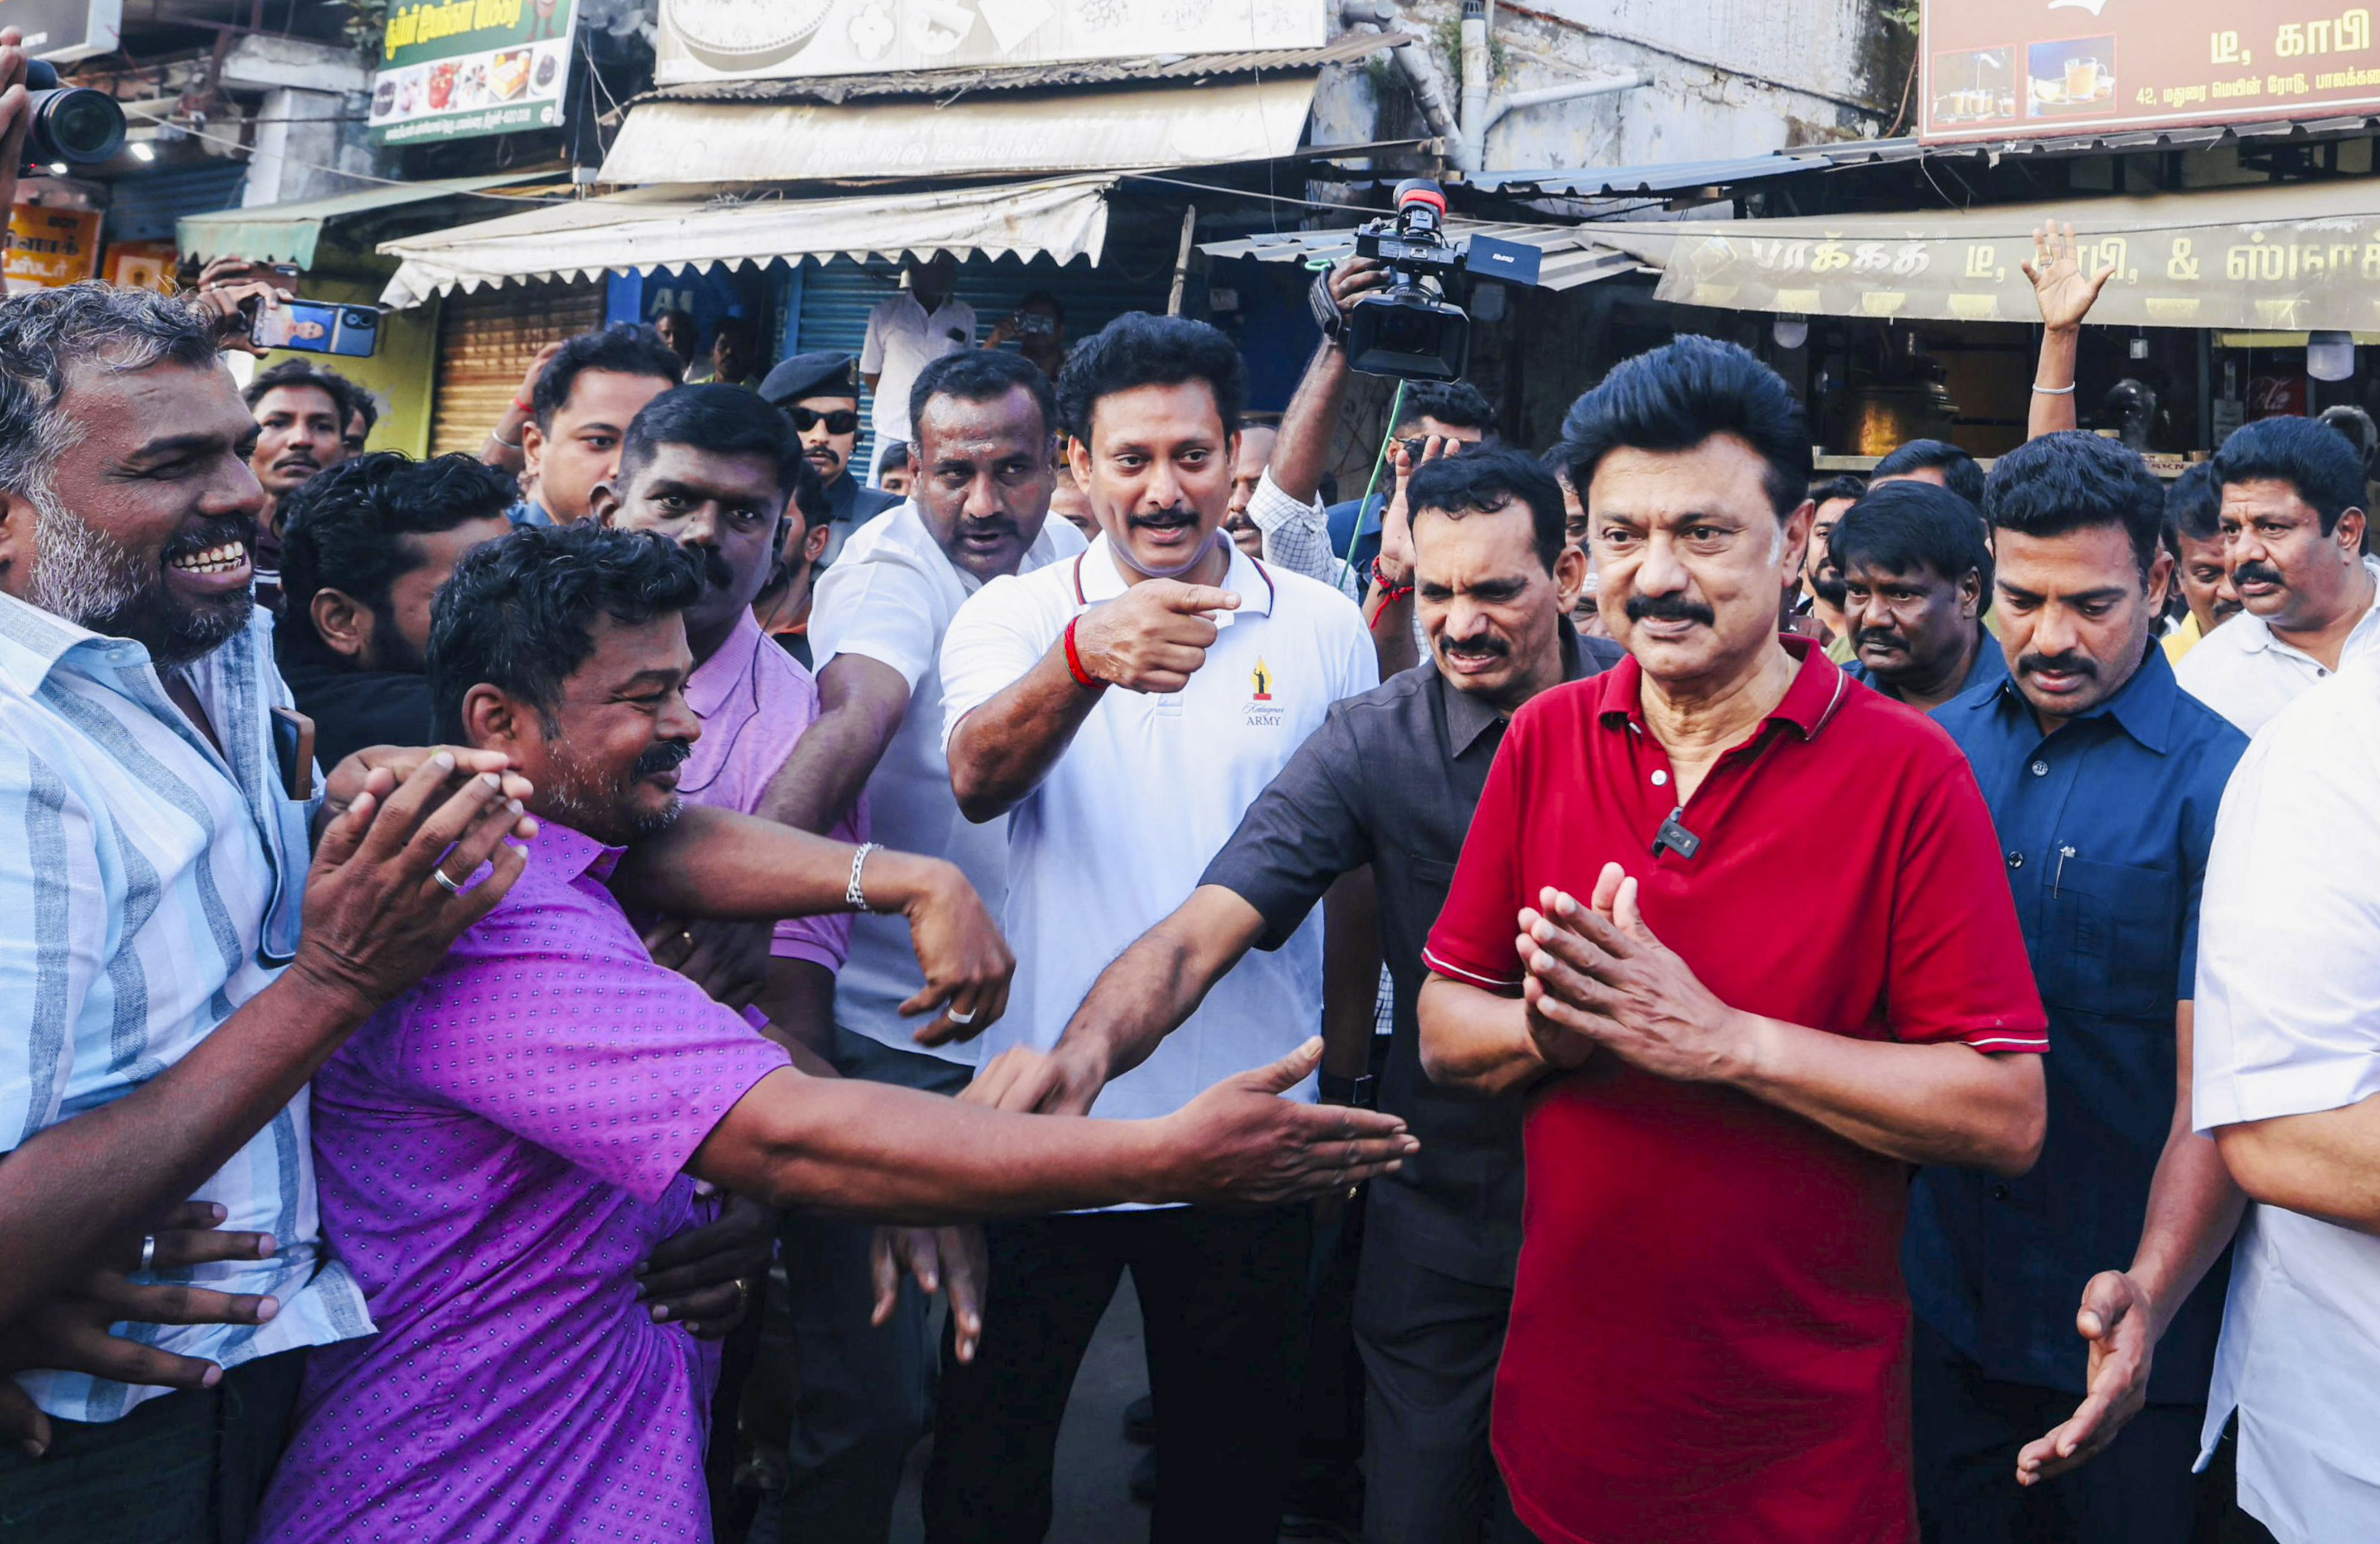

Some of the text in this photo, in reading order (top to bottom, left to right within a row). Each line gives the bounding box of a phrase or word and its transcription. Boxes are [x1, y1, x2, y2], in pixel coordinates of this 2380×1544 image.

[2275, 8, 2370, 57] காபி
[2136, 88, 2157, 106] 42,
[2162, 84, 2206, 107] மதுரை
[2211, 76, 2262, 98] மெயின்
[2267, 73, 2309, 95] ரோடு,
[2167, 237, 2200, 279] &
[1246, 716, 1281, 726] ARMY
